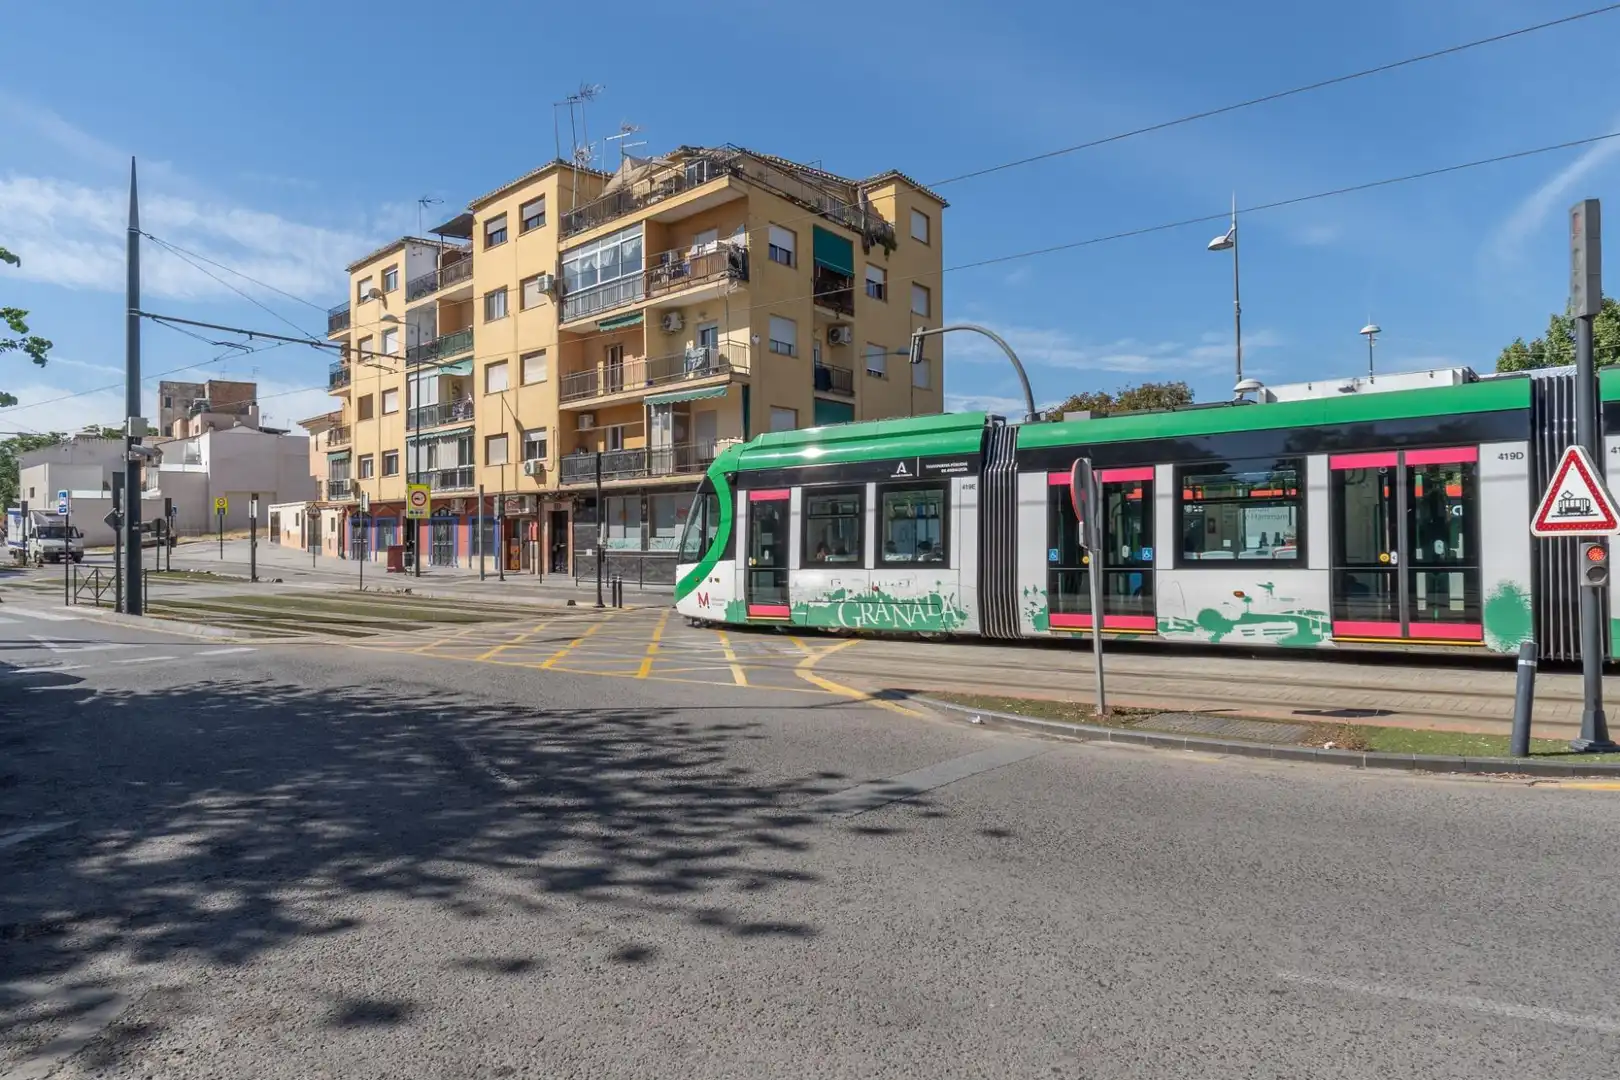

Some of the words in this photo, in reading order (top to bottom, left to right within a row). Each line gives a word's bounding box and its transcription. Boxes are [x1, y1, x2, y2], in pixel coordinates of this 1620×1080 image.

[1498, 452, 1524, 460] 419D
[697, 591, 710, 608] M
[837, 591, 959, 628] GRANADA
